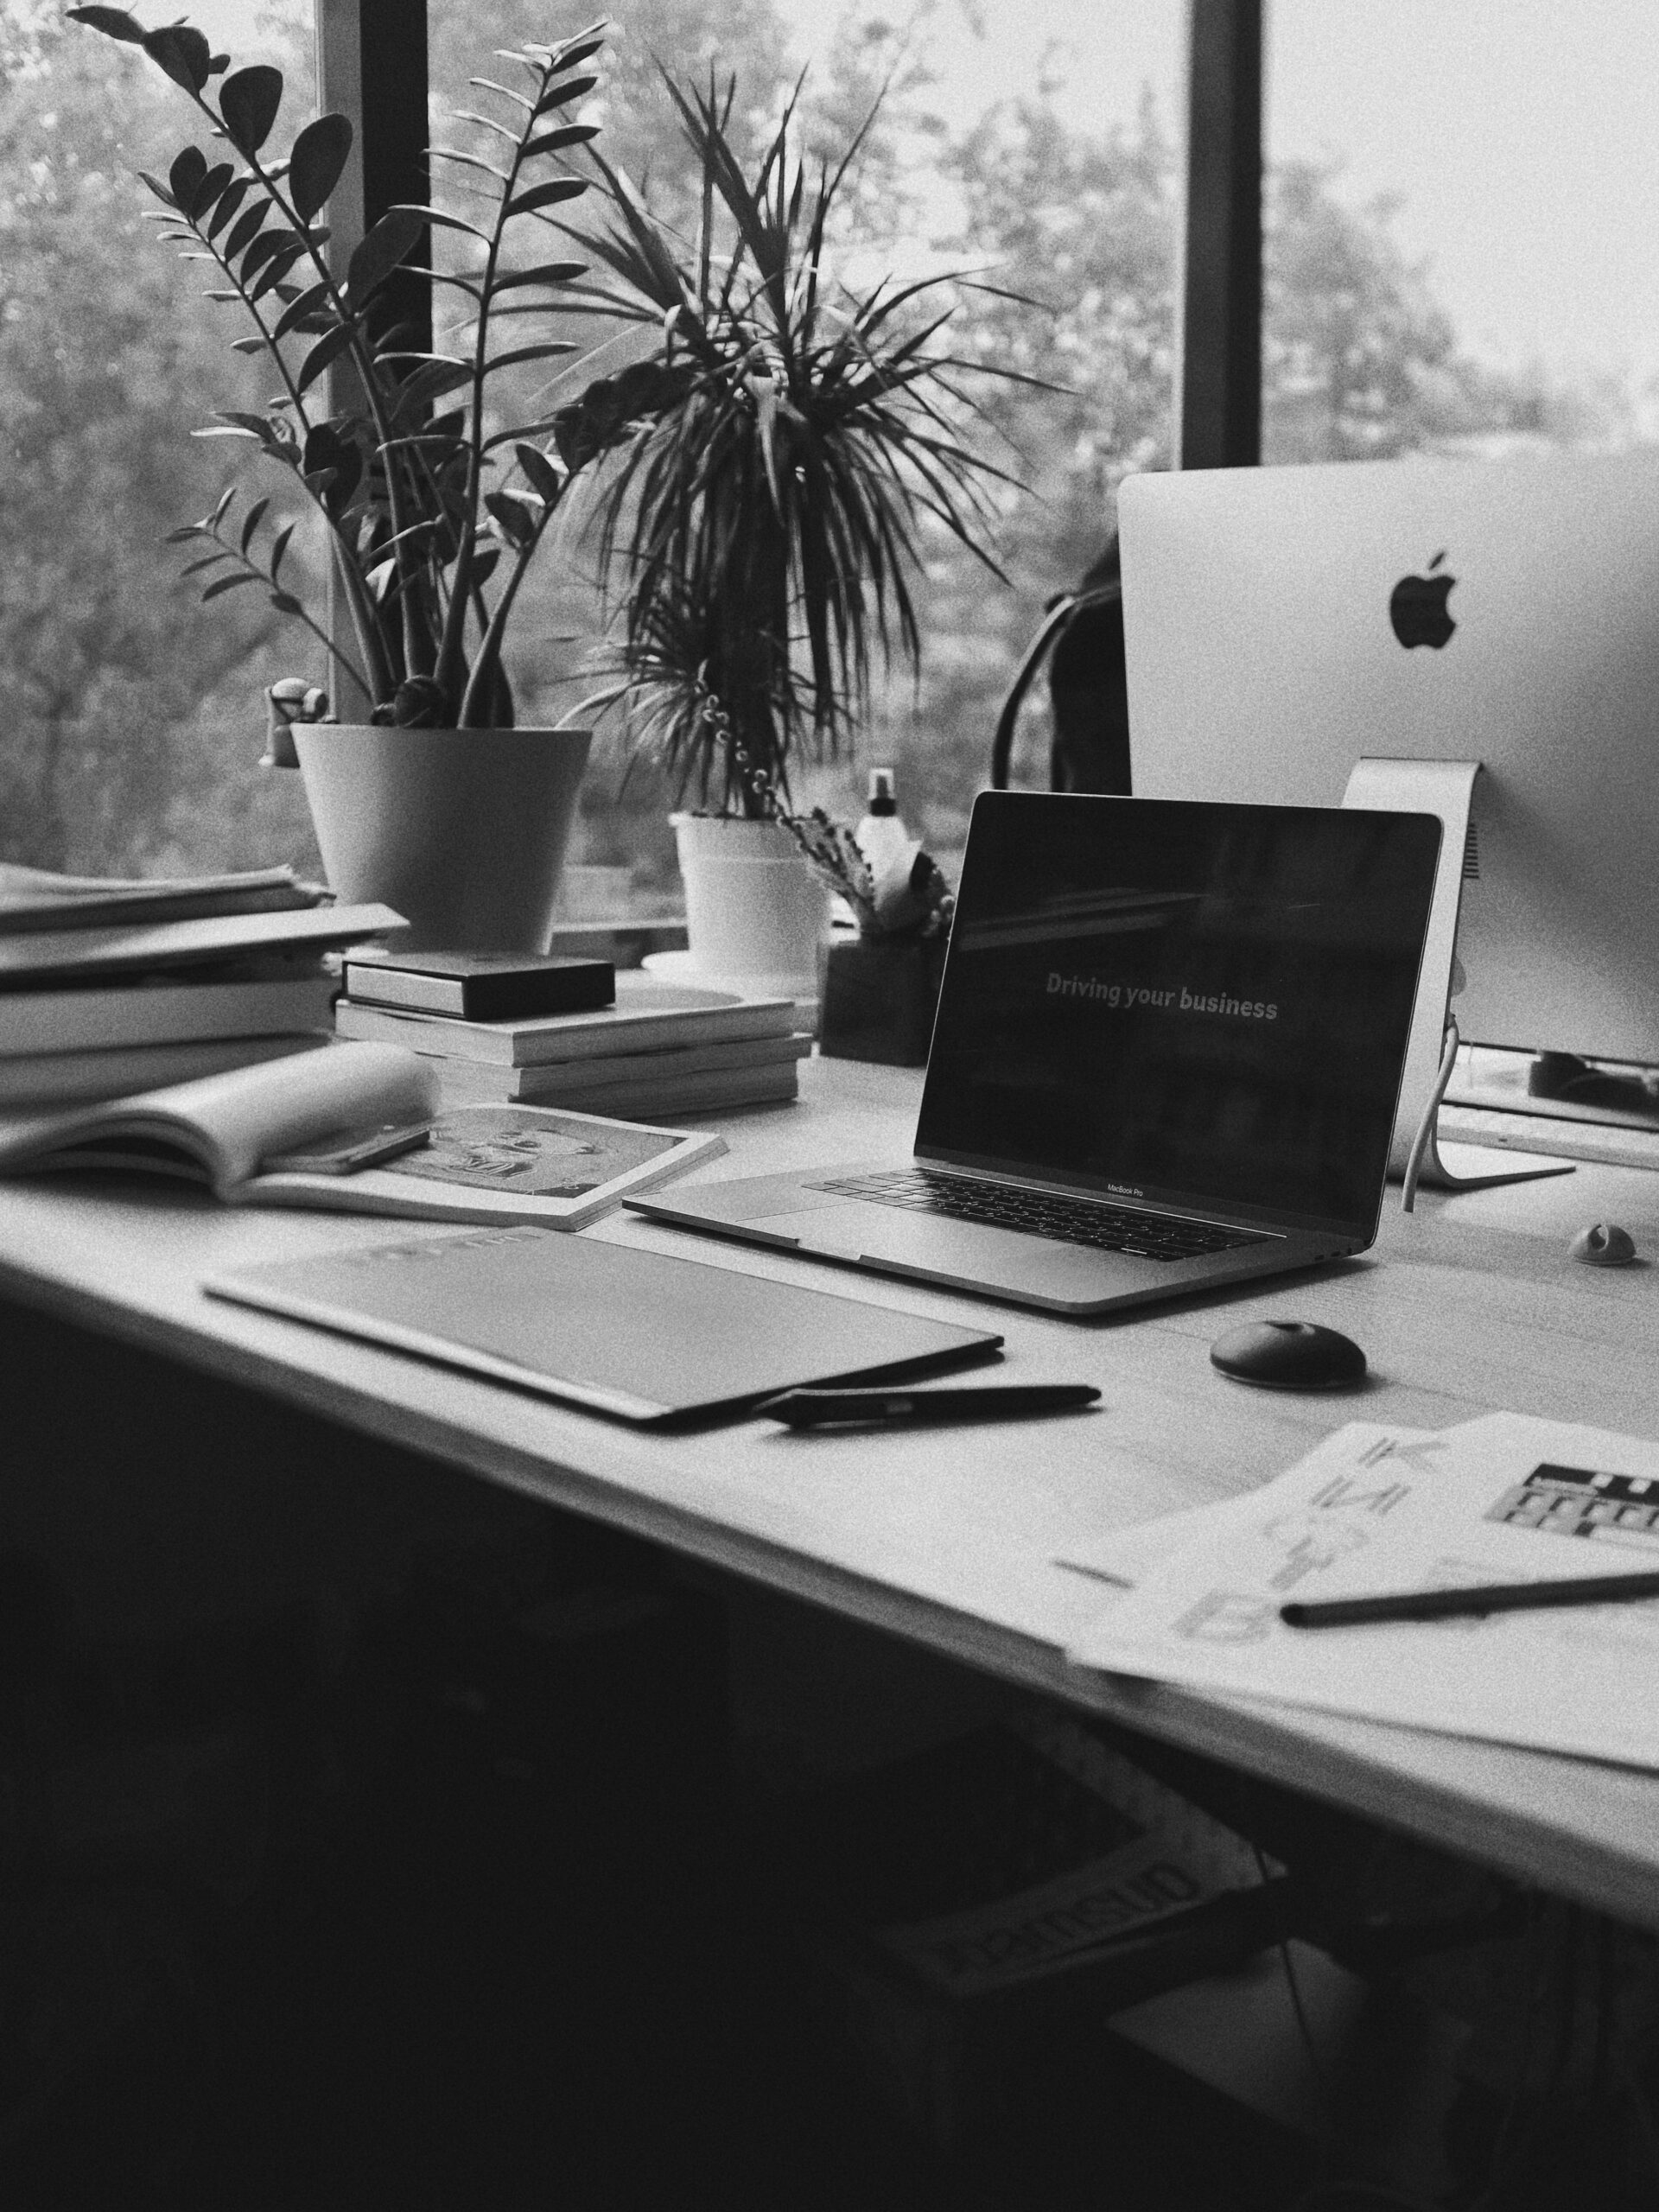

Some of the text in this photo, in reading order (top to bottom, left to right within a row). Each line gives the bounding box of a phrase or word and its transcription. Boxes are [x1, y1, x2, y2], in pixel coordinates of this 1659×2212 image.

[1046, 972, 1278, 1020] Driving your business
[1107, 1183, 1143, 1197] MacBook Pro
